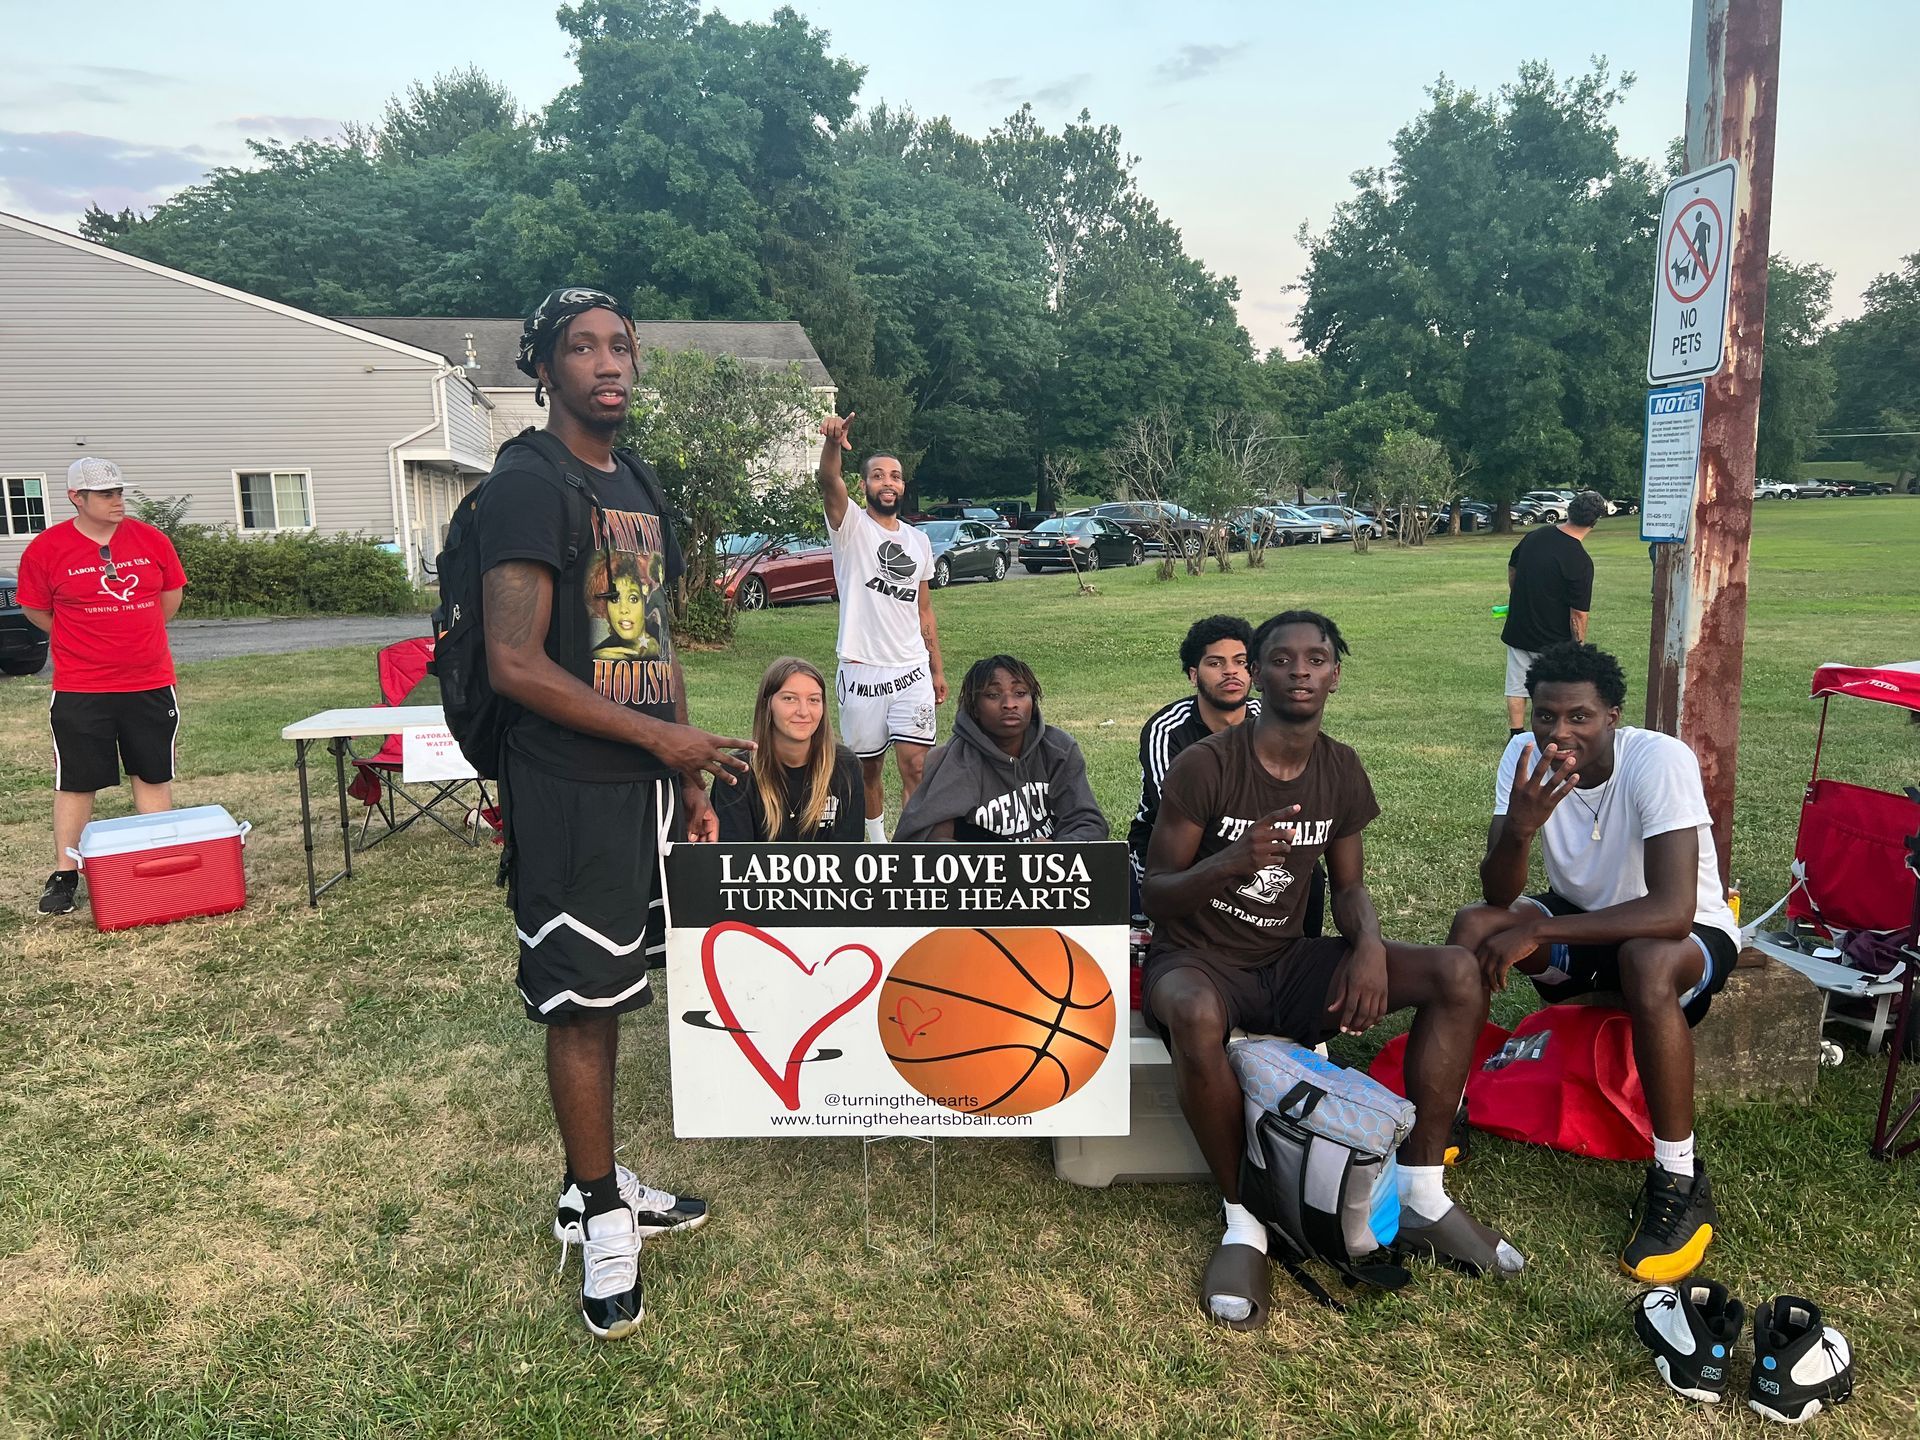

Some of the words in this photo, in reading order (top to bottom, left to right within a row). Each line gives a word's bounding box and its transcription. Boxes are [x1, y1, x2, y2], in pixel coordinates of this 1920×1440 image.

[1680, 307, 1697, 330] NO
[1672, 333, 1702, 356] PETS
[68, 566, 96, 576] LABOR
[134, 557, 151, 566] USA
[865, 576, 917, 603] AWB
[84, 605, 119, 614] TURNING
[121, 604, 135, 612] THE
[848, 681, 855, 694] A
[856, 681, 894, 697] WALKING
[893, 667, 926, 692] BUCKET
[1217, 816, 1255, 841] TH
[720, 853, 843, 884] LABOR
[854, 853, 900, 884] OF
[912, 853, 1007, 884] LOVE
[1019, 853, 1092, 884] USA
[720, 888, 875, 912] TURNING
[881, 888, 950, 911] THE
[958, 887, 1091, 911] HEARTS
[824, 1093, 979, 1110] @turningthehearts
[770, 1112, 1033, 1128] www.turningtheheartsbball.com
